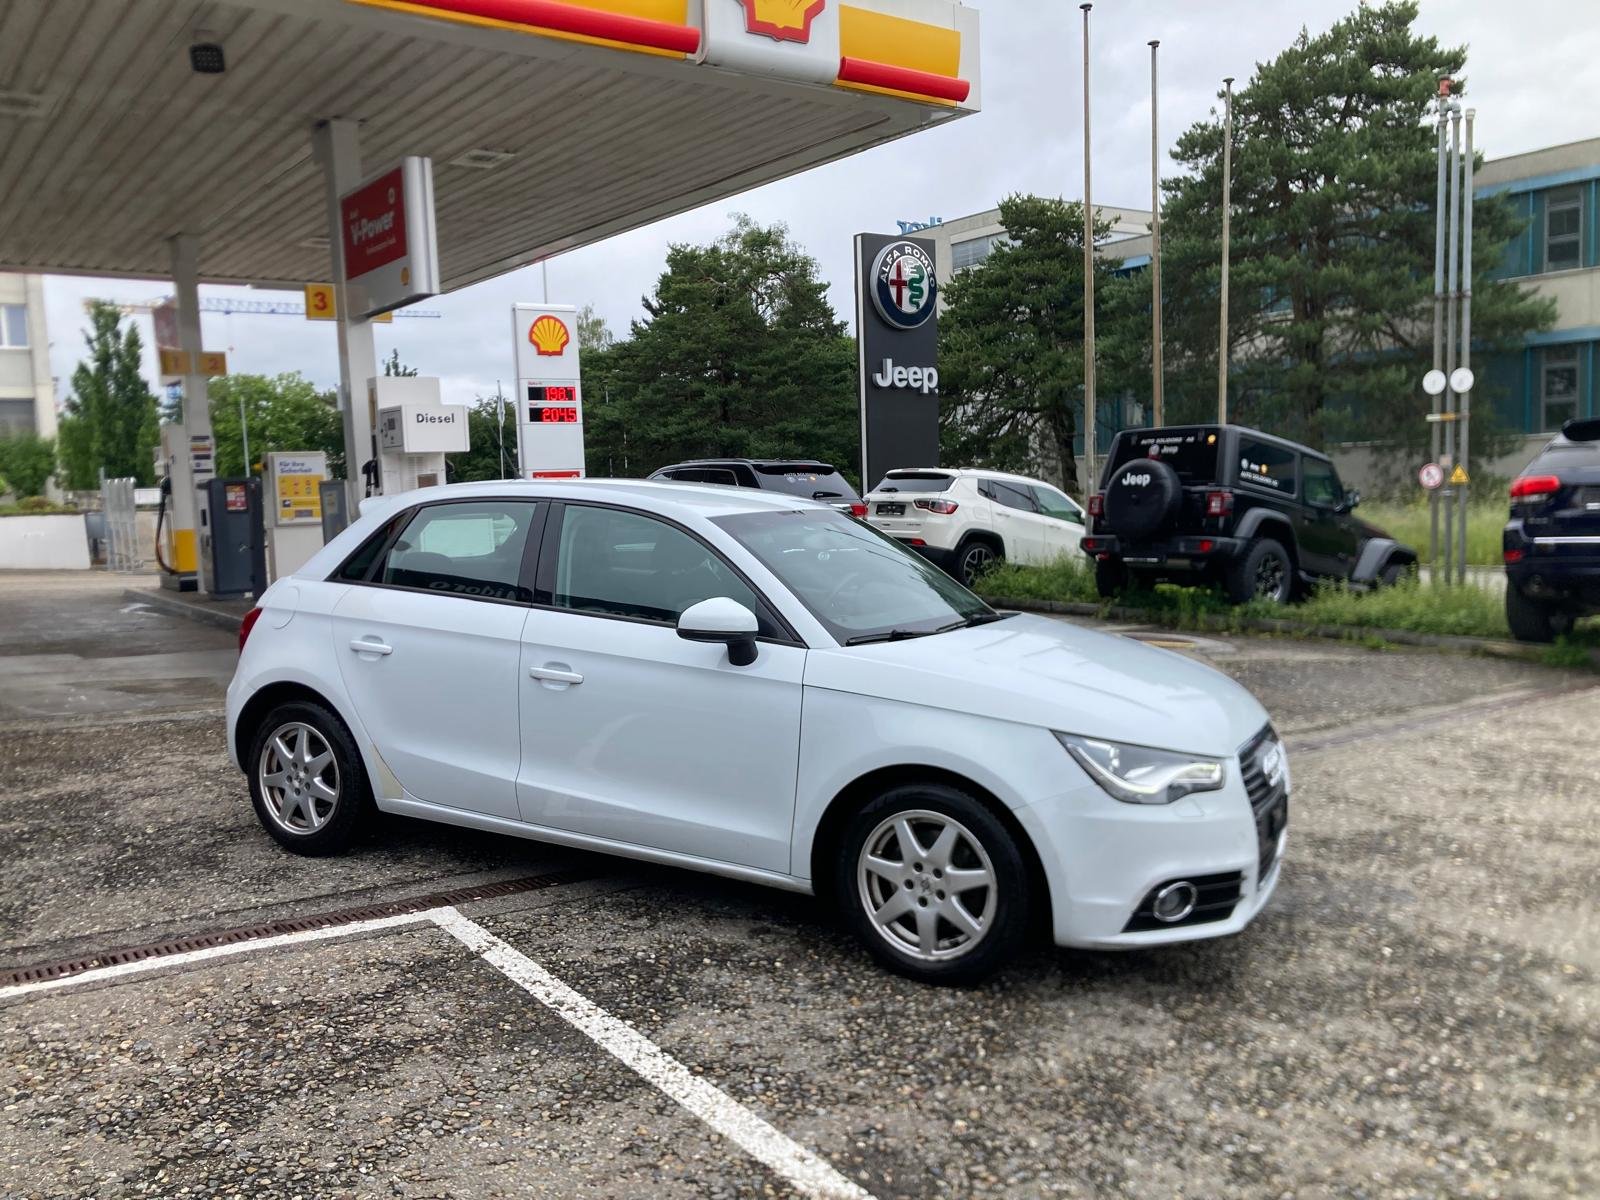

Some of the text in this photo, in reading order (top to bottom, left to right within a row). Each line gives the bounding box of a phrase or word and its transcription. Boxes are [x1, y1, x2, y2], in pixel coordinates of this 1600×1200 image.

[880, 245, 936, 288] ALFA ROMEO
[313, 291, 328, 311] 3
[208, 356, 220, 371] 2
[872, 358, 939, 394] Jeep
[416, 412, 455, 424] Diesel
[1160, 445, 1179, 454] Jeep
[1121, 472, 1151, 487] Jeep
